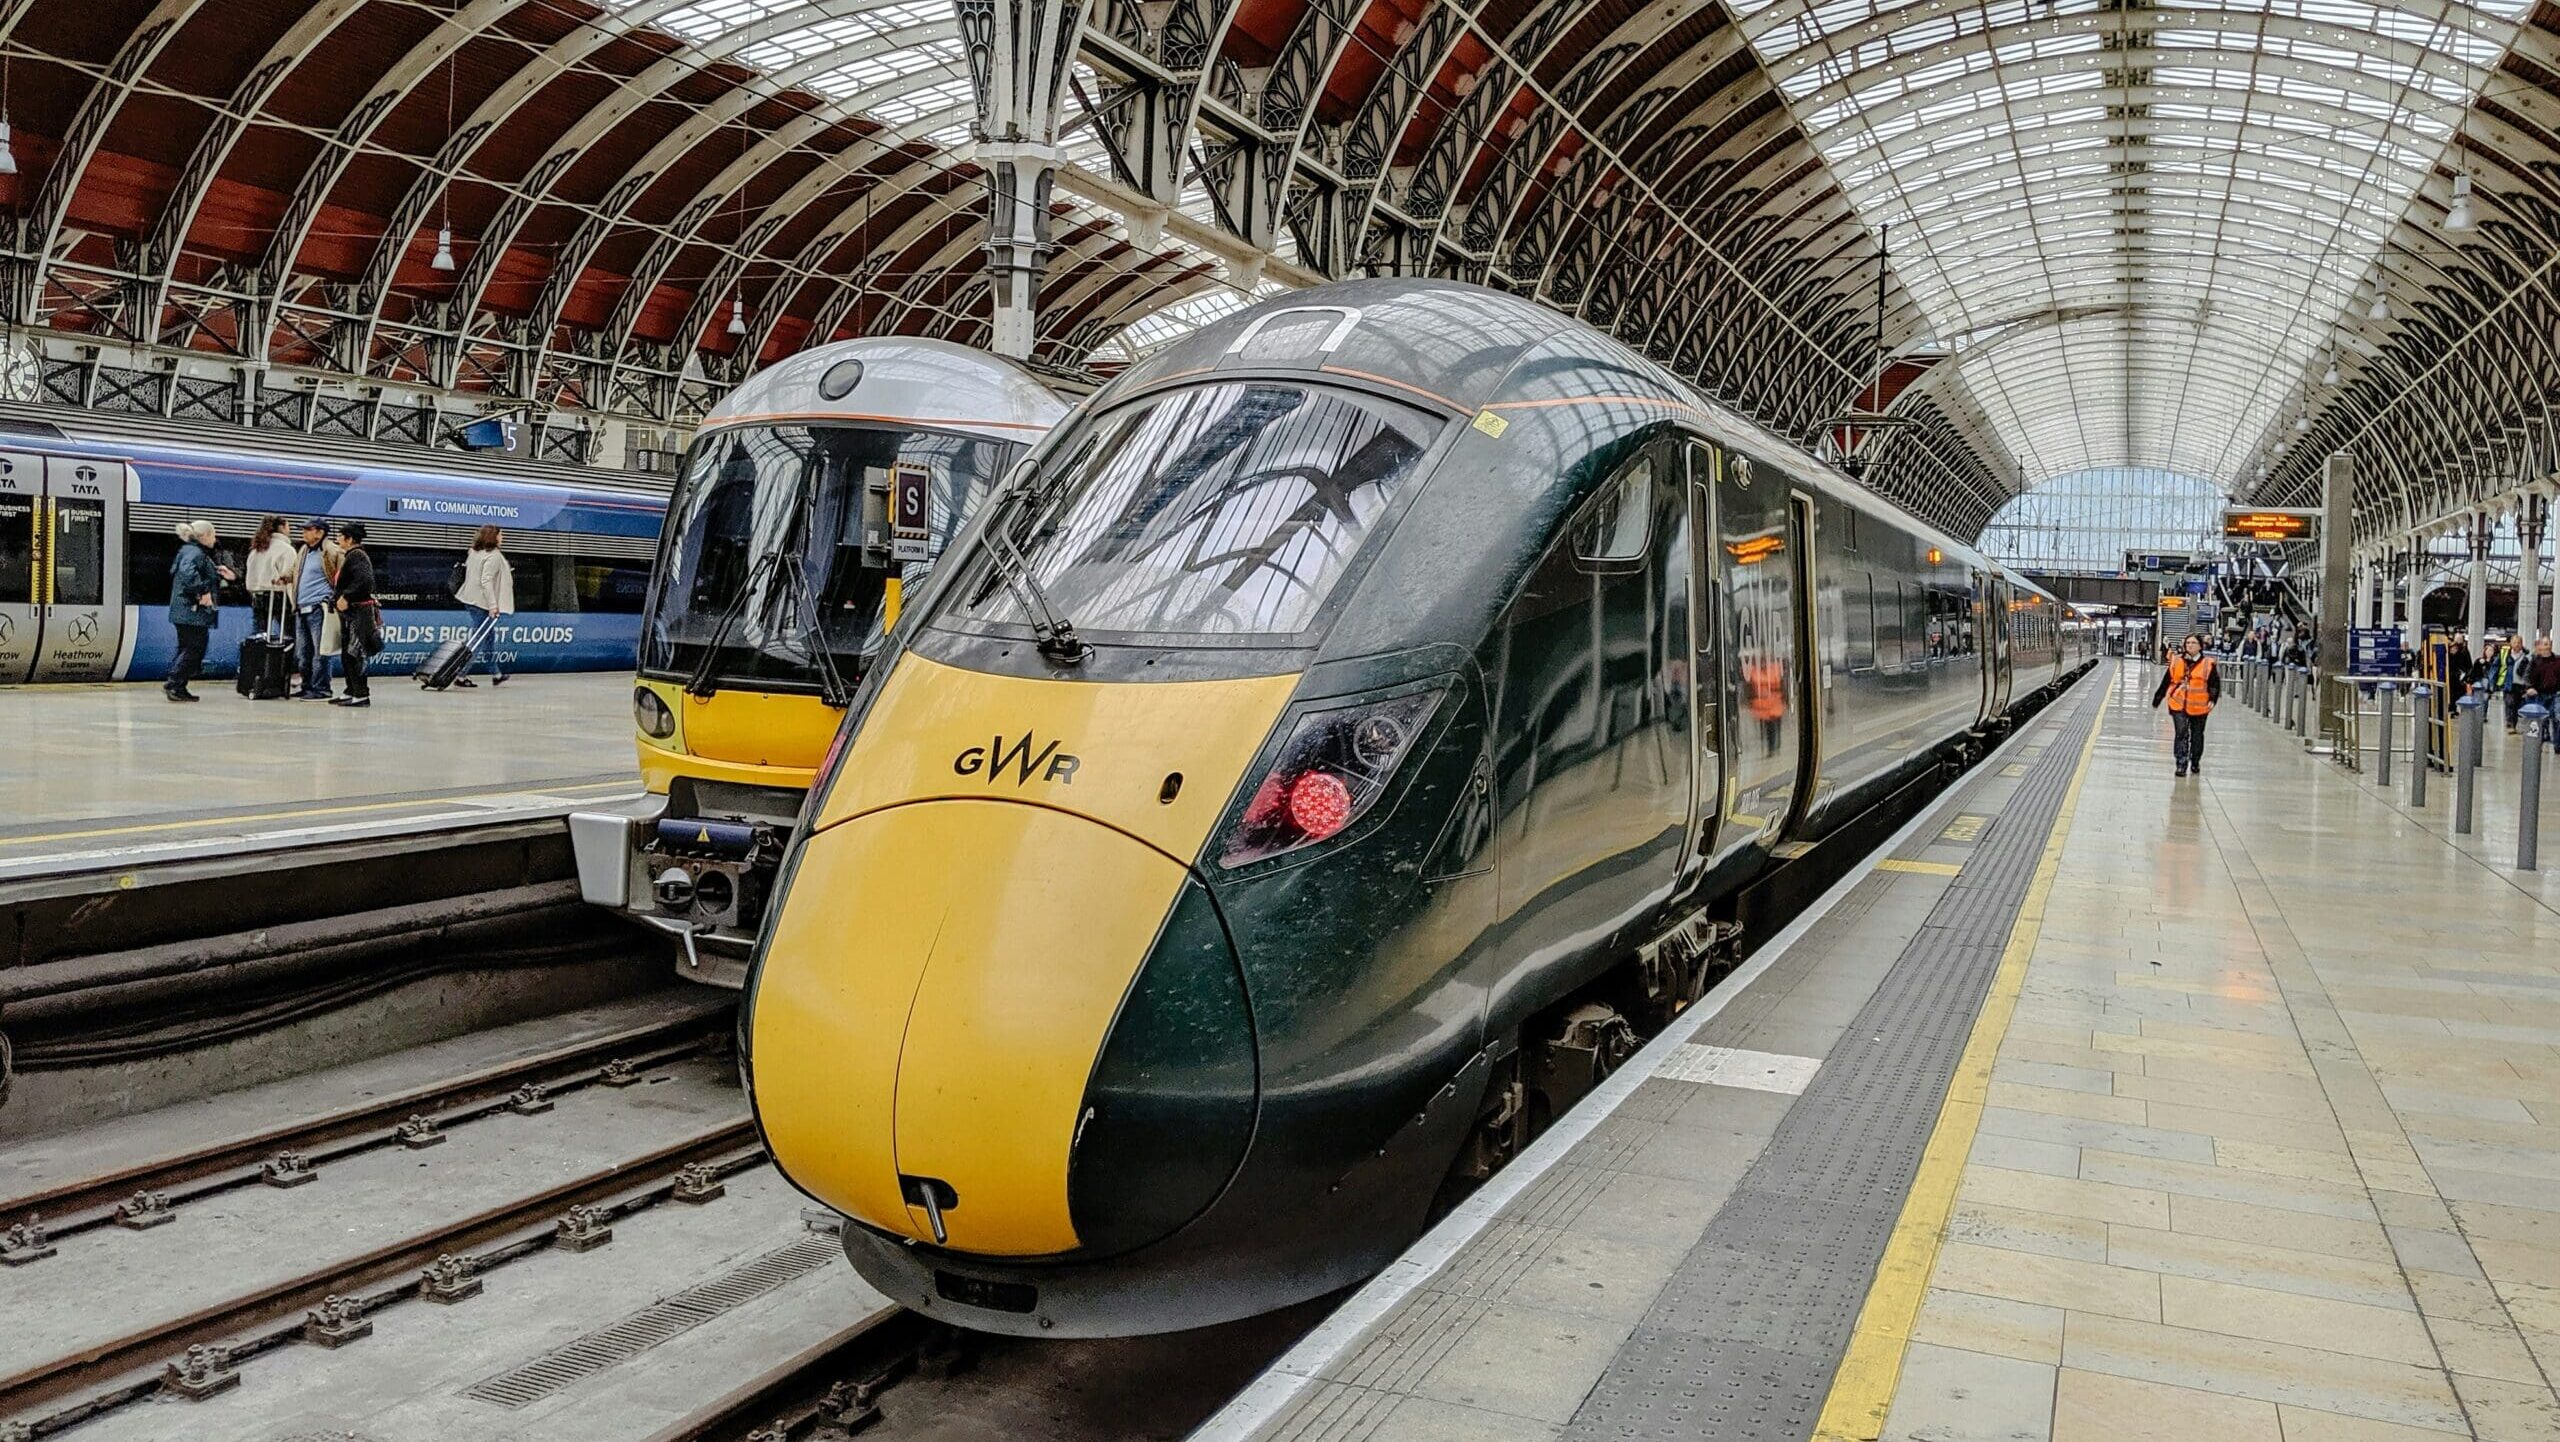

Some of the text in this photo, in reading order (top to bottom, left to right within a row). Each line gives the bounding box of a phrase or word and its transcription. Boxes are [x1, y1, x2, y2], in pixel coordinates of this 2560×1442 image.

[506, 426, 518, 452] 5
[0, 479, 17, 489] TA
[71, 484, 101, 495] TATA
[401, 498, 519, 518] TATA COMMUNICATIONS
[906, 486, 919, 515] S
[59, 508, 70, 533] 1
[70, 509, 102, 517] BUSINESS
[70, 515, 89, 523] FIRST
[380, 626, 574, 644] RLD'S BIGT CLOUDS
[53, 650, 104, 660] Heathrow
[369, 651, 411, 665] WE'RE
[953, 727, 1081, 788] GWR
